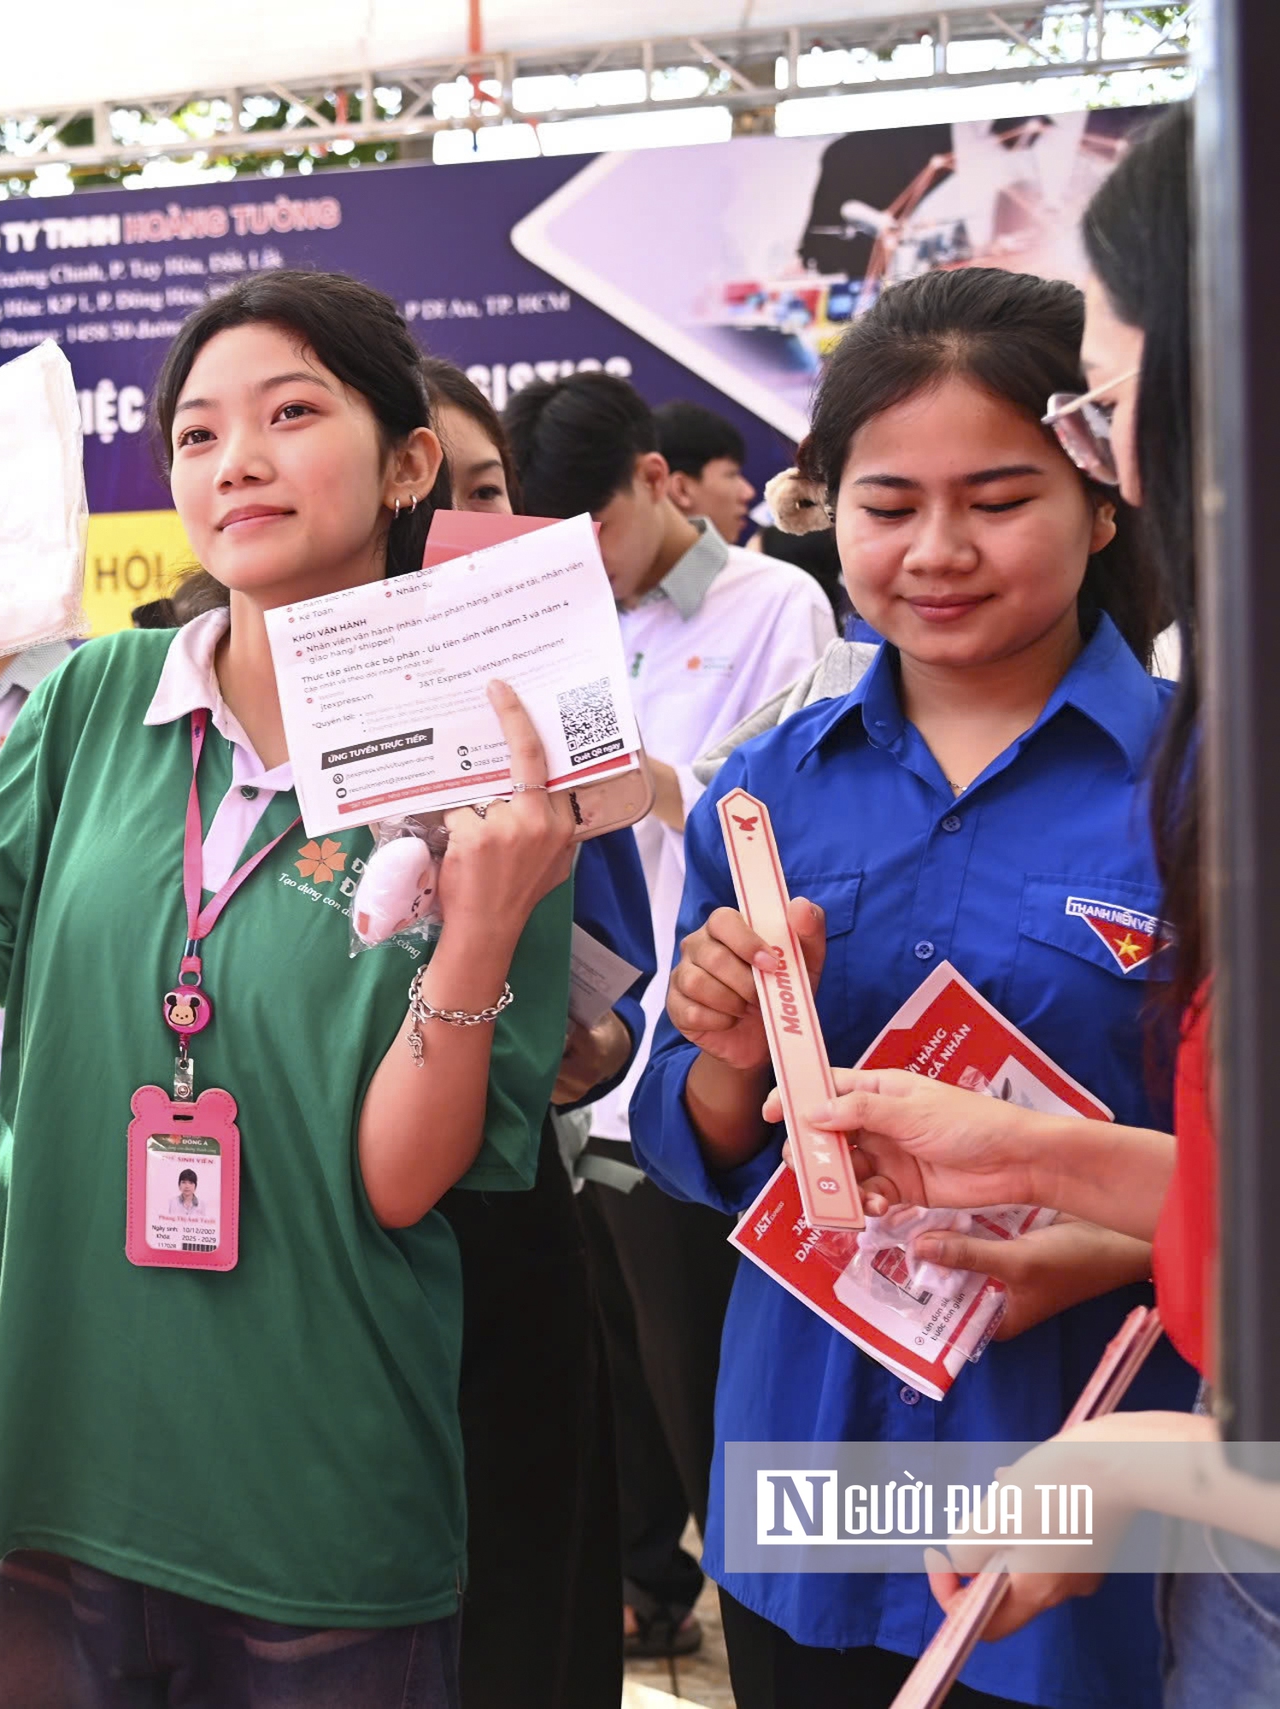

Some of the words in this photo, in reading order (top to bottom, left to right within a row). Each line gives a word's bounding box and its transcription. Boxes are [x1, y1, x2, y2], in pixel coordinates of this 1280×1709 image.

[1, 221, 41, 253] TY
[47, 293, 76, 314] KP
[517, 292, 570, 314] HCM
[523, 614, 528, 622] 3
[437, 669, 471, 684] Express
[592, 748, 602, 757] QR
[323, 895, 341, 910] con
[1071, 903, 1110, 921] THANH
[917, 1028, 947, 1065] HÀNG
[928, 1059, 945, 1079] CÁ
[940, 1023, 971, 1061] NHÂN
[820, 1182, 838, 1190] 02
[753, 1210, 772, 1241] J&T
